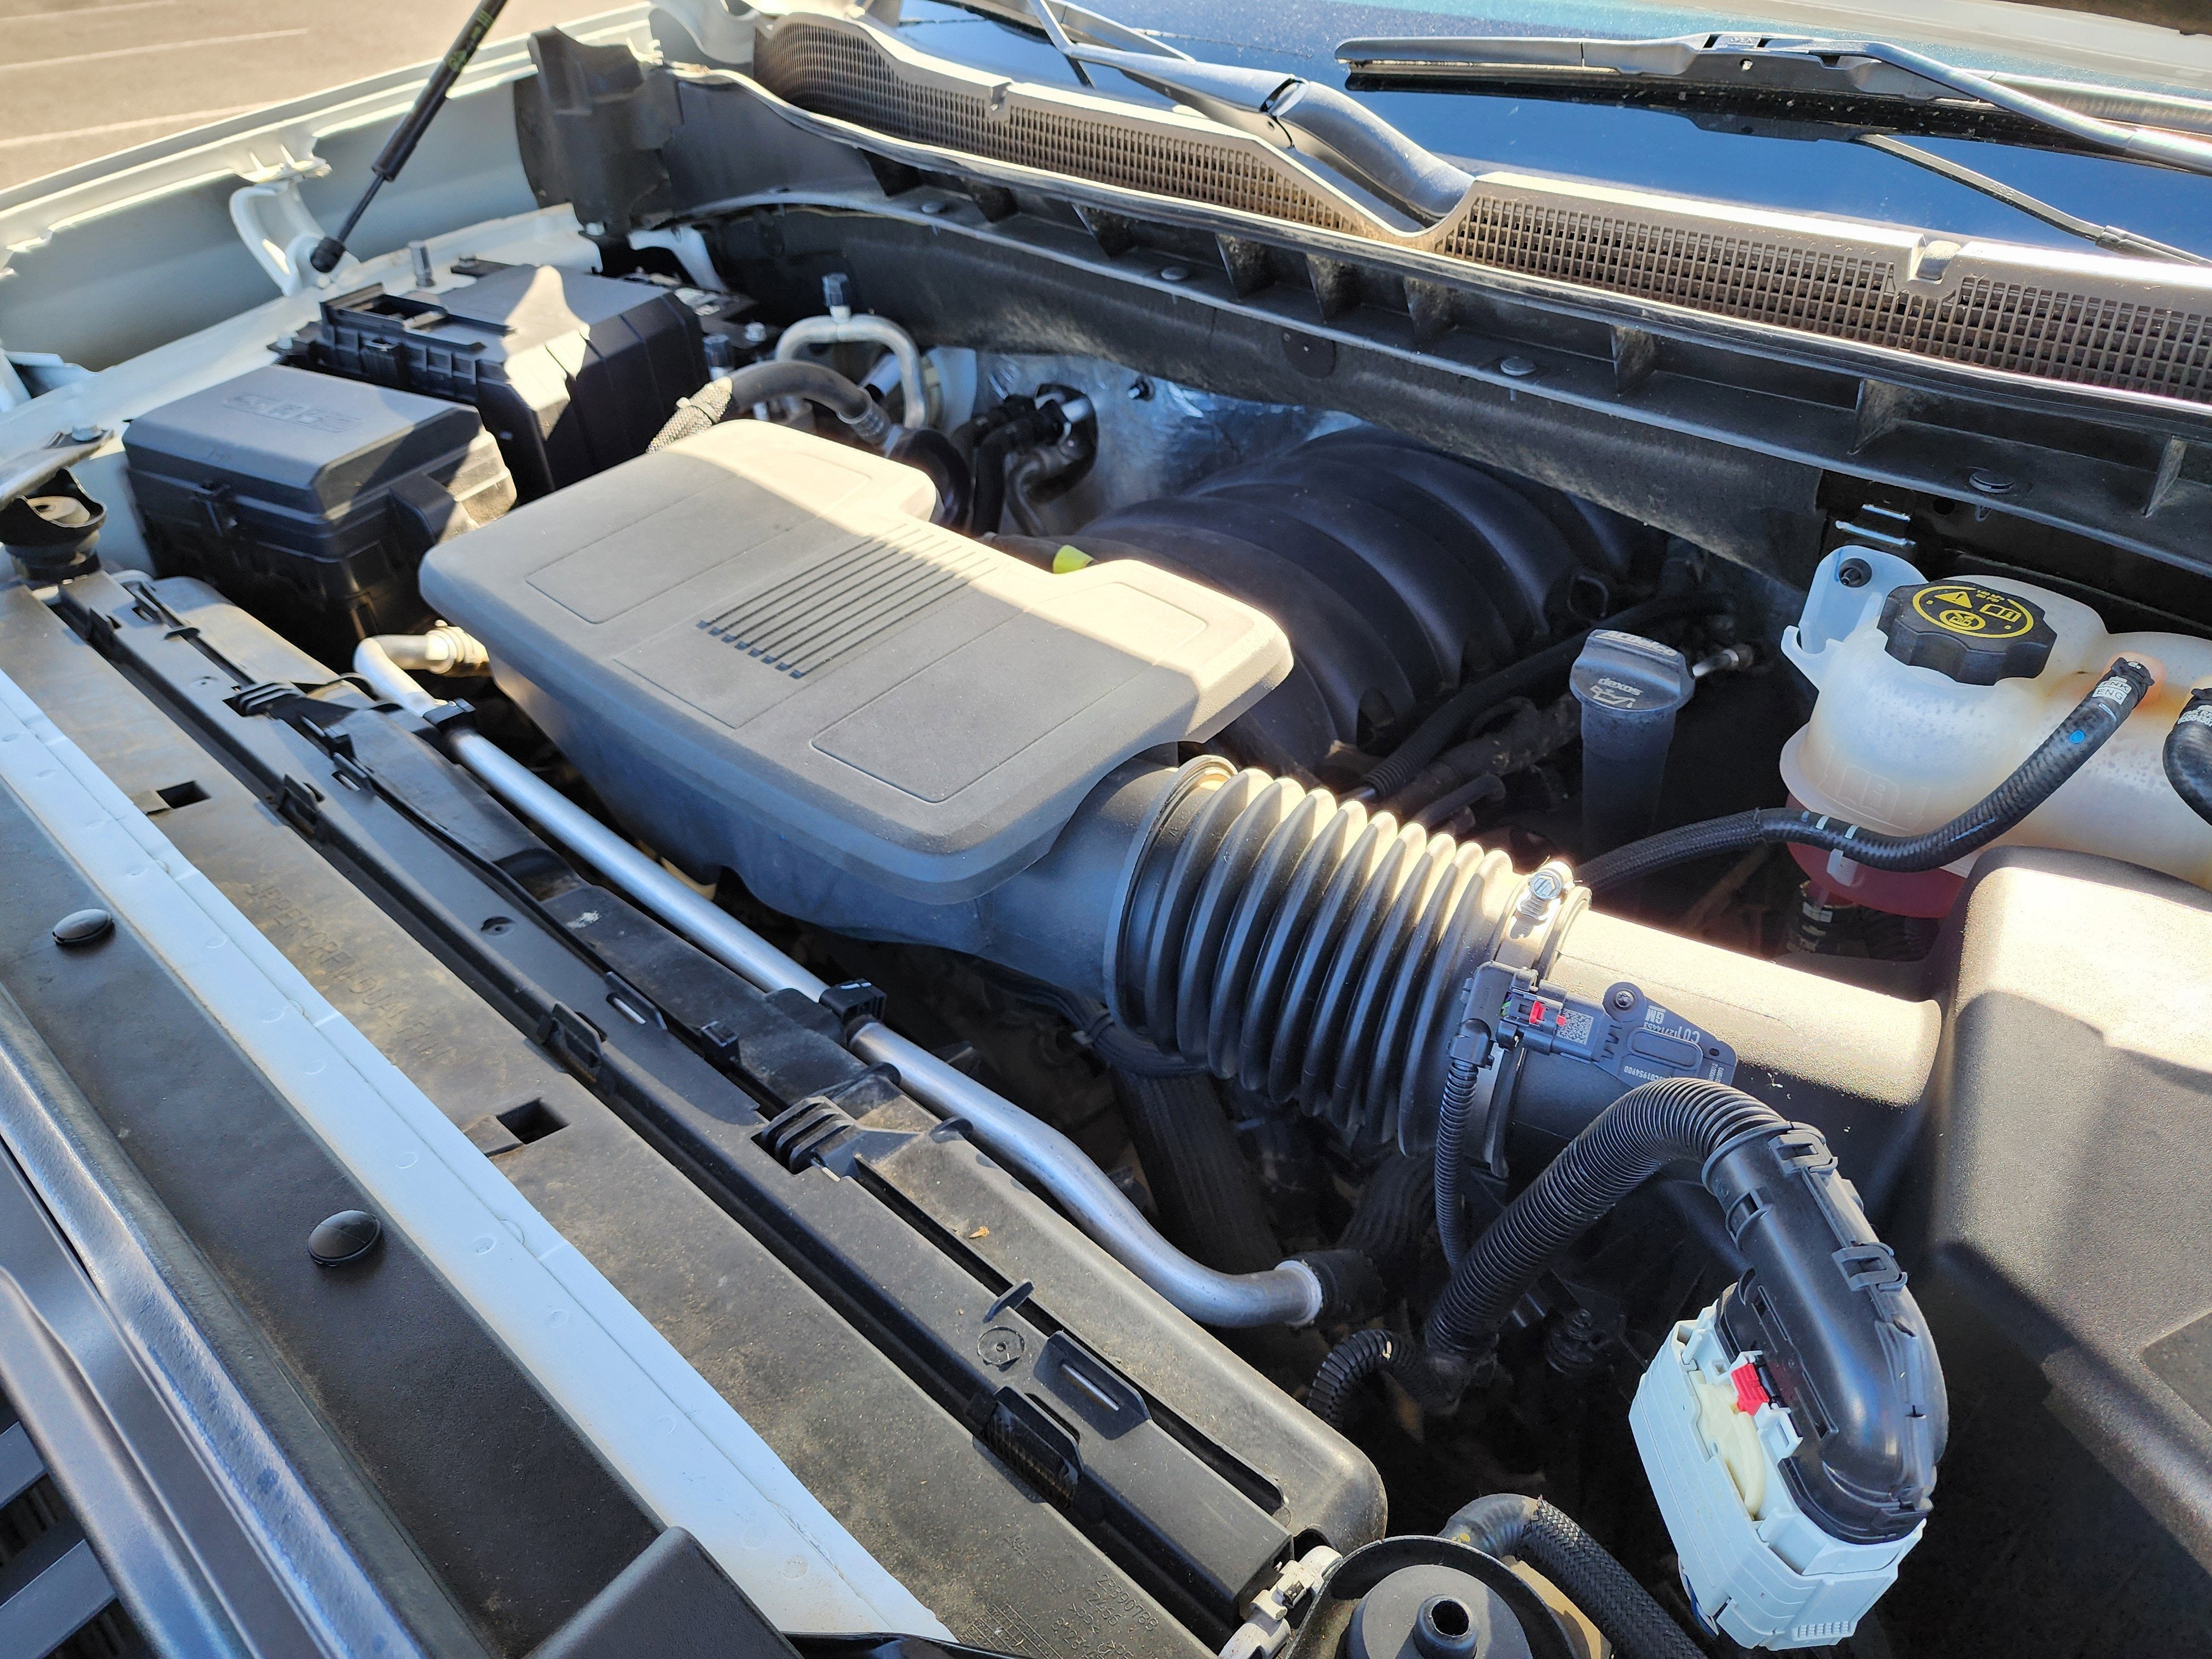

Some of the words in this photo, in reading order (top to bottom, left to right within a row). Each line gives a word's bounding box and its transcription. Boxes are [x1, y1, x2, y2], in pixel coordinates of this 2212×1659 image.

[1598, 677, 1643, 696] dexos
[2096, 688, 2124, 700] ENG
[1645, 1008, 1665, 1024] GM
